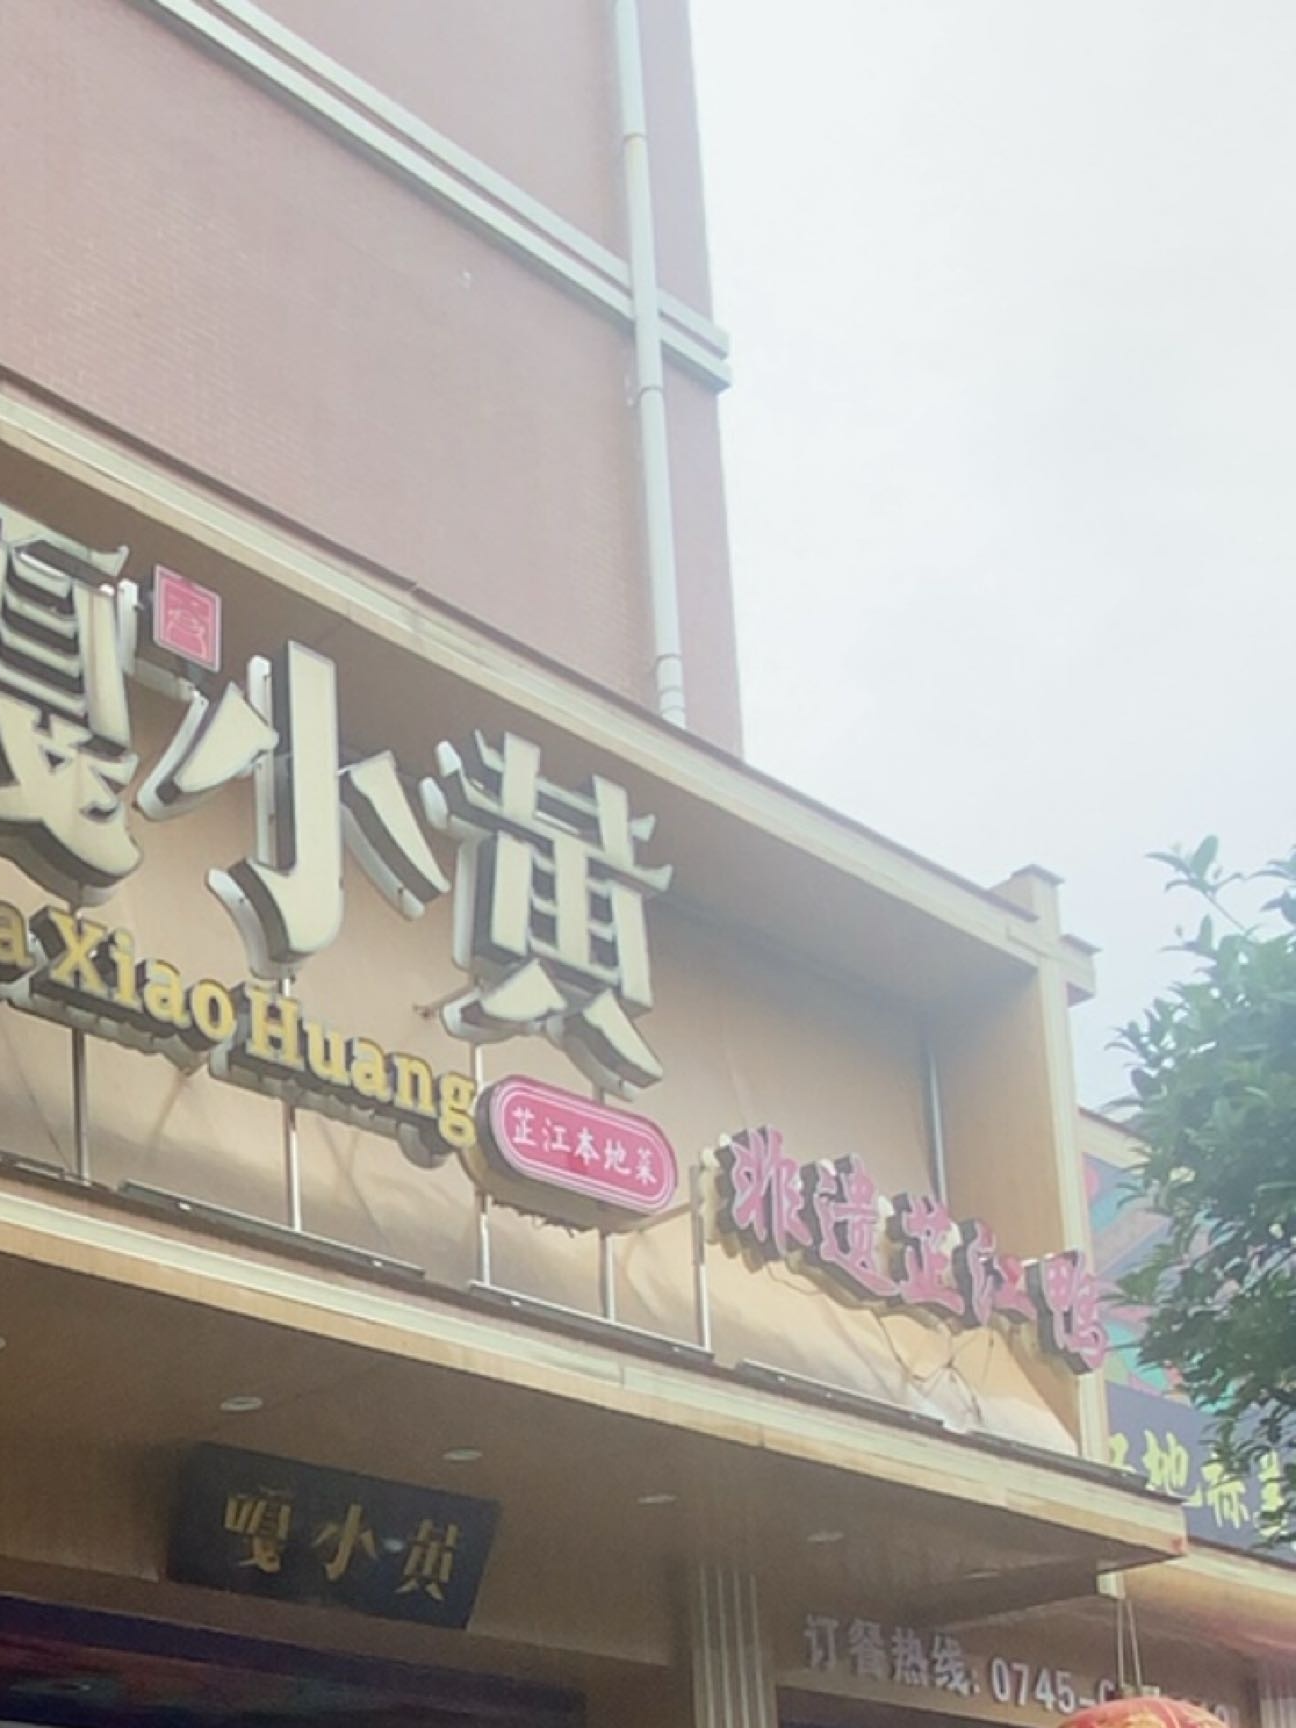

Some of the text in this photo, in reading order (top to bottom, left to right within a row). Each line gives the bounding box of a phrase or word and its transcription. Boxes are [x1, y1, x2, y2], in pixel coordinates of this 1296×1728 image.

[48, 906, 237, 1042] Xiao
[244, 984, 478, 1148] Huang
[511, 1106, 658, 1186] 芷江本地菜
[730, 1124, 1109, 1370] 非遗芷江鸭
